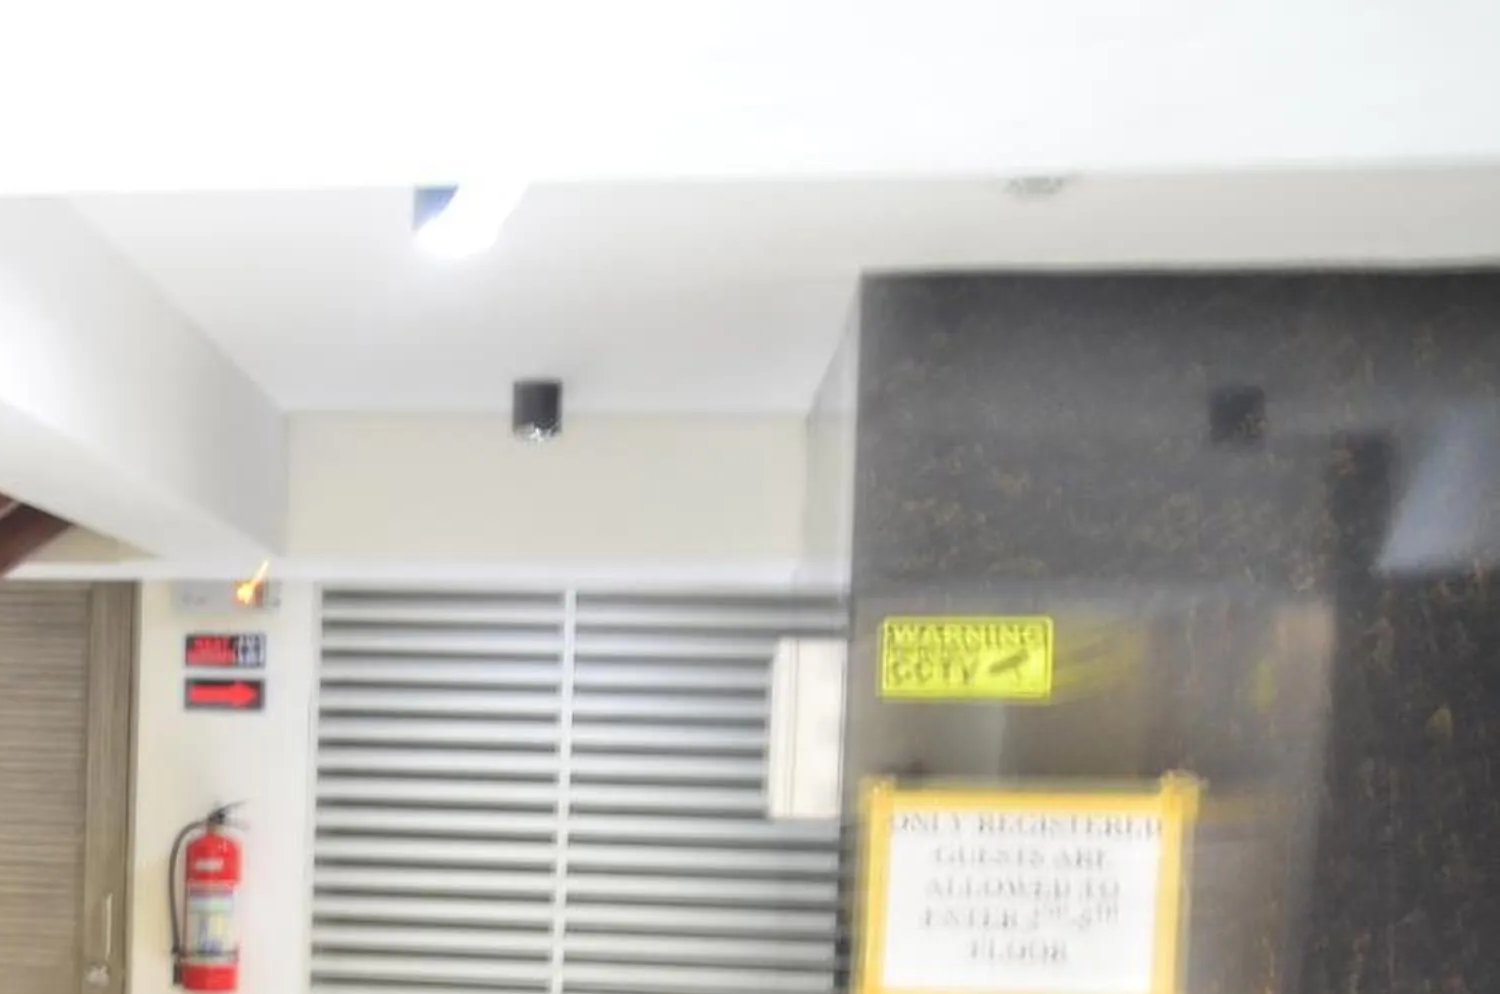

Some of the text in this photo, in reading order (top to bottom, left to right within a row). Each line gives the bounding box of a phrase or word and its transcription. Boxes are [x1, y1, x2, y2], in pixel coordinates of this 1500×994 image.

[889, 621, 1043, 649] WARNING
[890, 658, 978, 687] CCTV
[977, 813, 1162, 840] REGISTERED
[934, 846, 1107, 870] GUESTS ARE
[927, 876, 1121, 900] ALLOWED TO
[921, 906, 1018, 930] ENTER
[970, 938, 1069, 963] FLOOR
